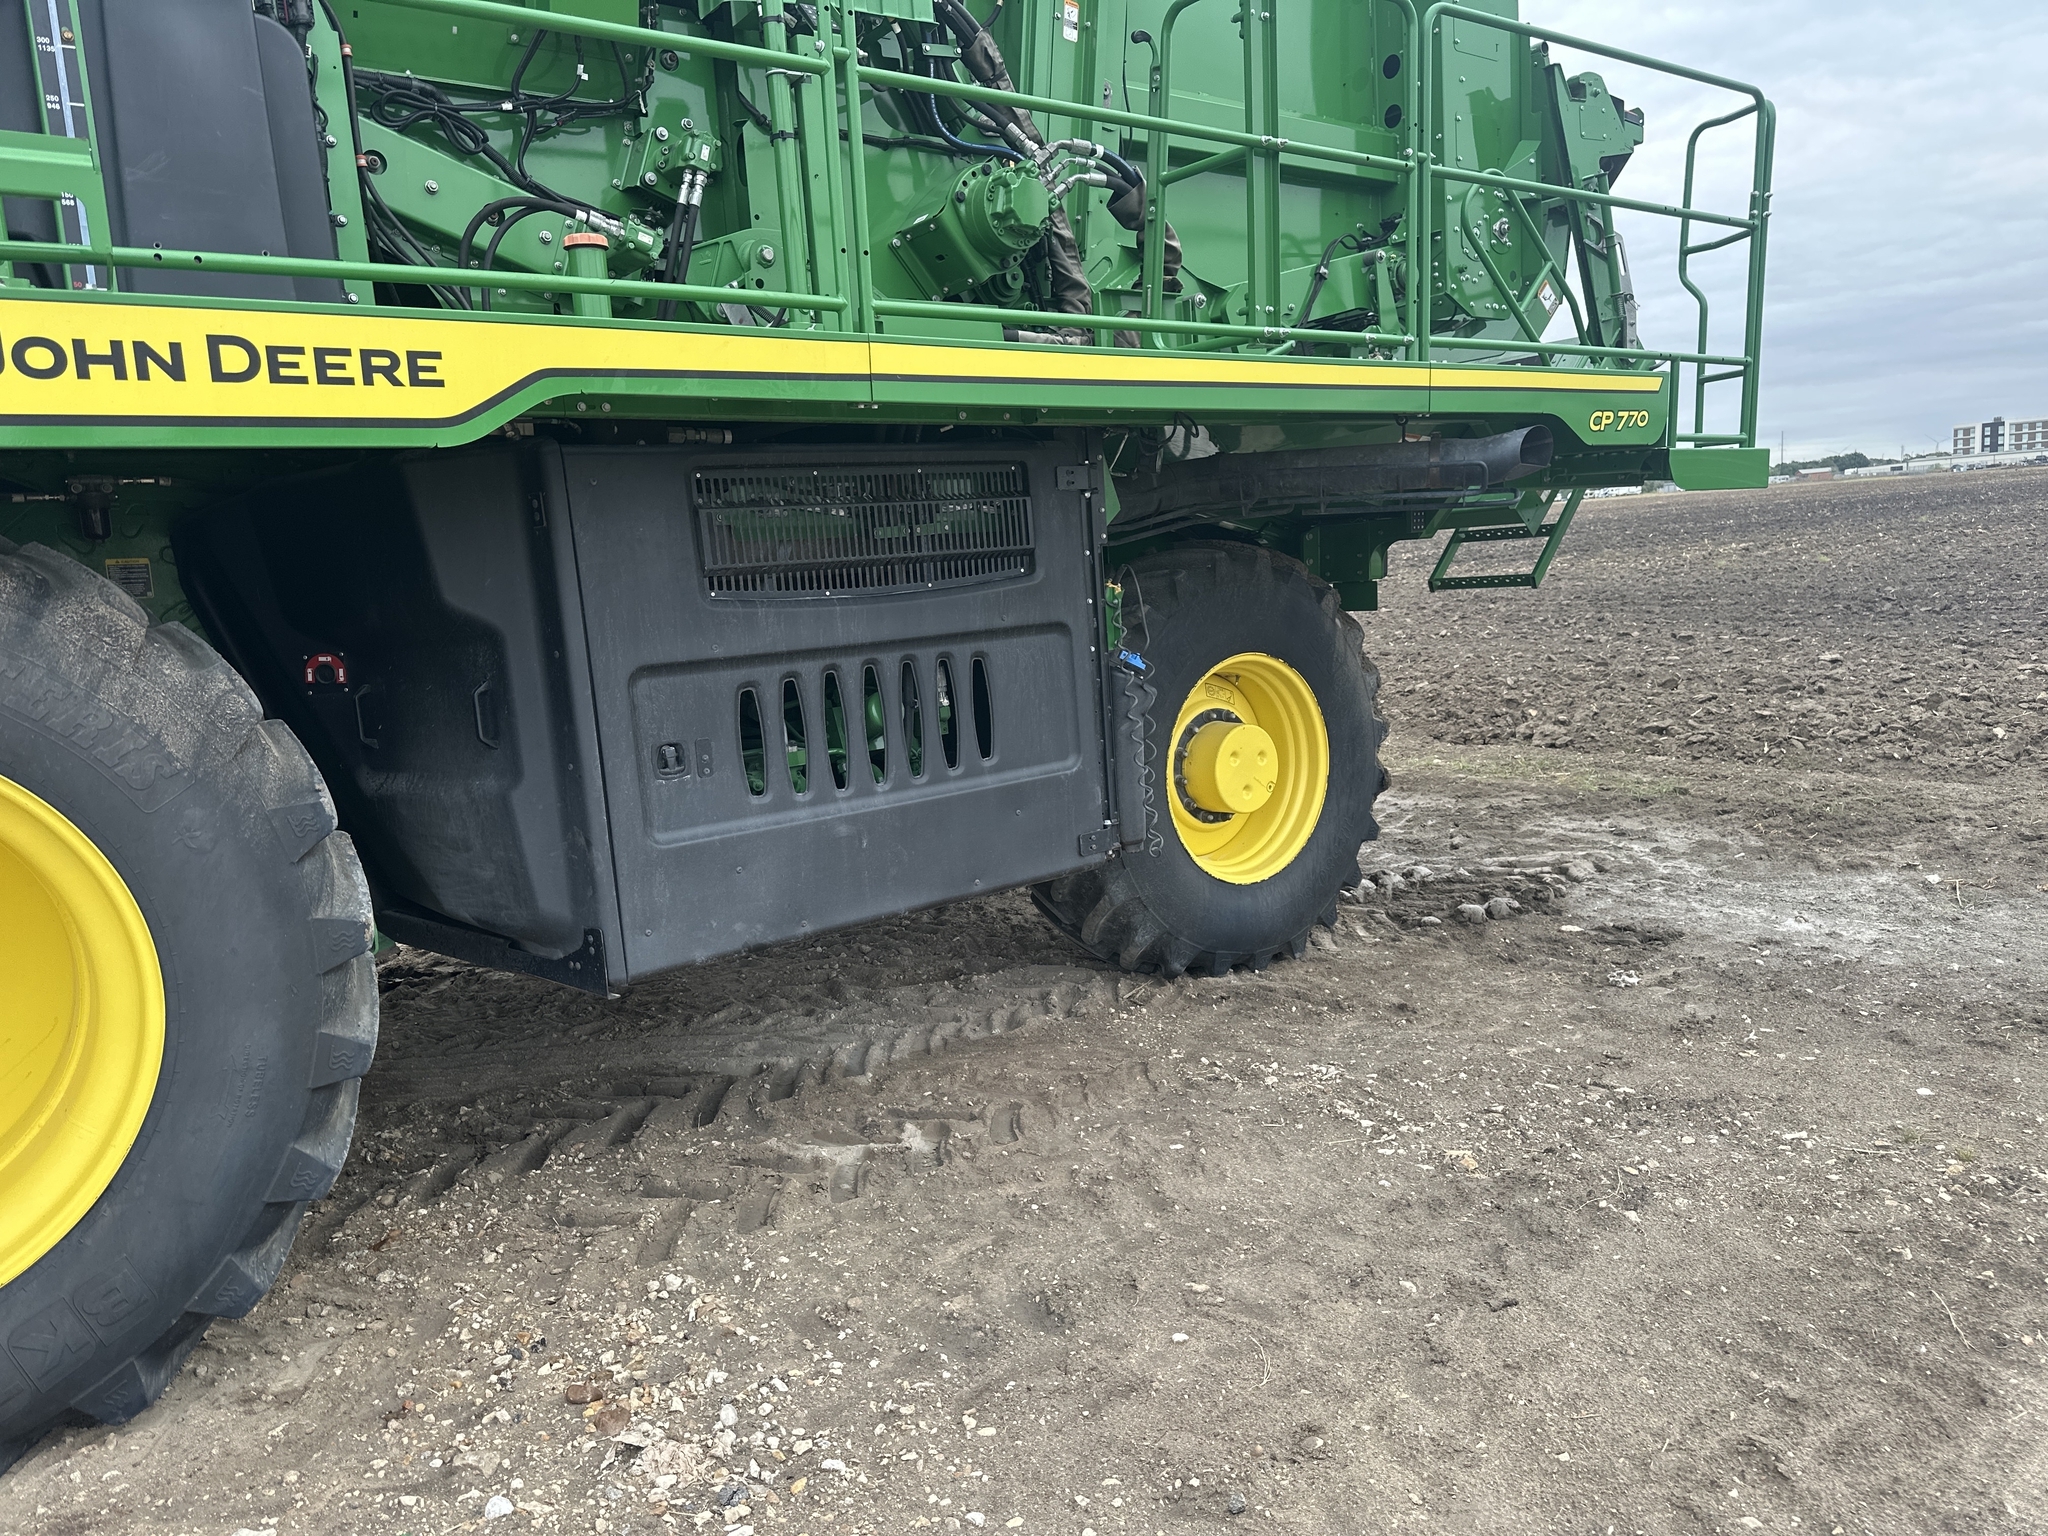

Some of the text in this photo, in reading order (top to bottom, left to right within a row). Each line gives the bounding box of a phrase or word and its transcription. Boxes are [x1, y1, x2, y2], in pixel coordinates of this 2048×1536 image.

[36, 36, 50, 44] 300
[45, 94, 59, 102] 250
[0, 333, 446, 388] OHN DEERE
[1589, 410, 1649, 432] CP 770
[244, 1055, 269, 1118] TUBELESS
